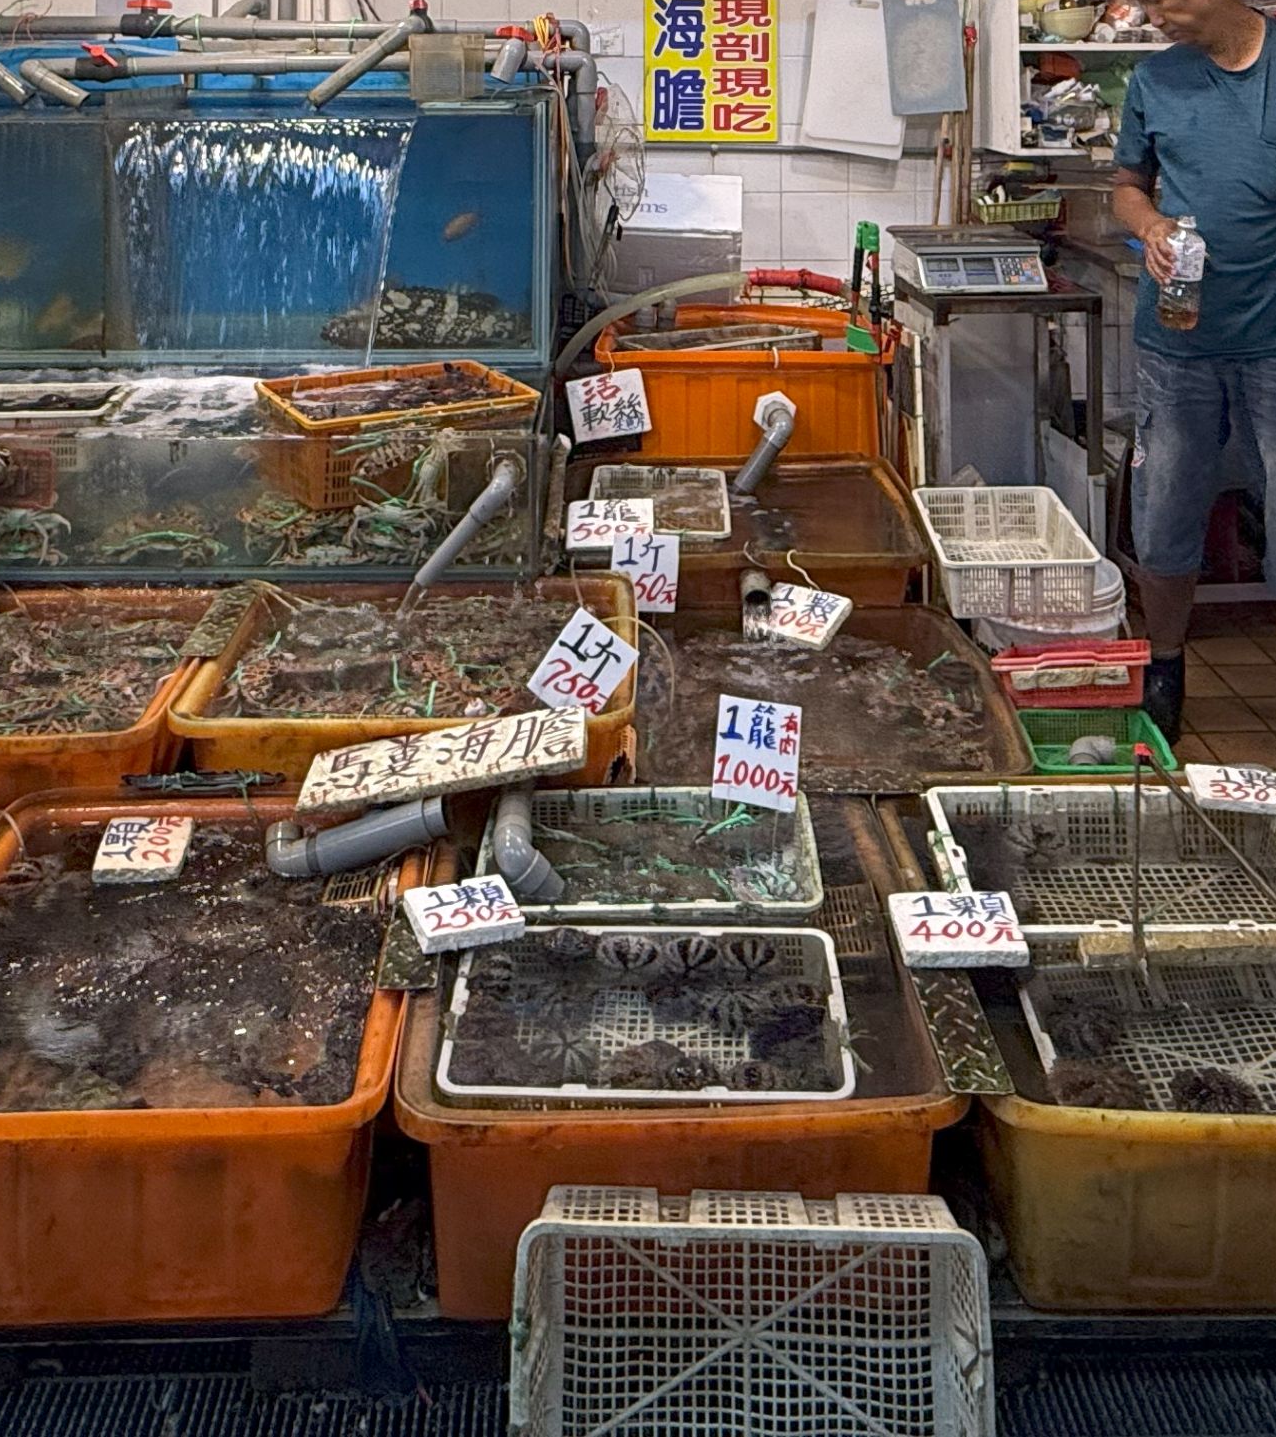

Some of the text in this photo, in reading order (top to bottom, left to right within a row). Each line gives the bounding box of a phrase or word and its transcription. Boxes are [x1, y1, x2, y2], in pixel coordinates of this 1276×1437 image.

[582, 374, 621, 403] 活
[572, 523, 648, 542] 500元
[616, 533, 665, 572] 1斤
[559, 623, 621, 683] 1斤
[312, 706, 583, 789] 馬糞海膽
[714, 754, 797, 797] 1000元
[425, 905, 520, 932] 250元
[909, 920, 1025, 944] 400元
